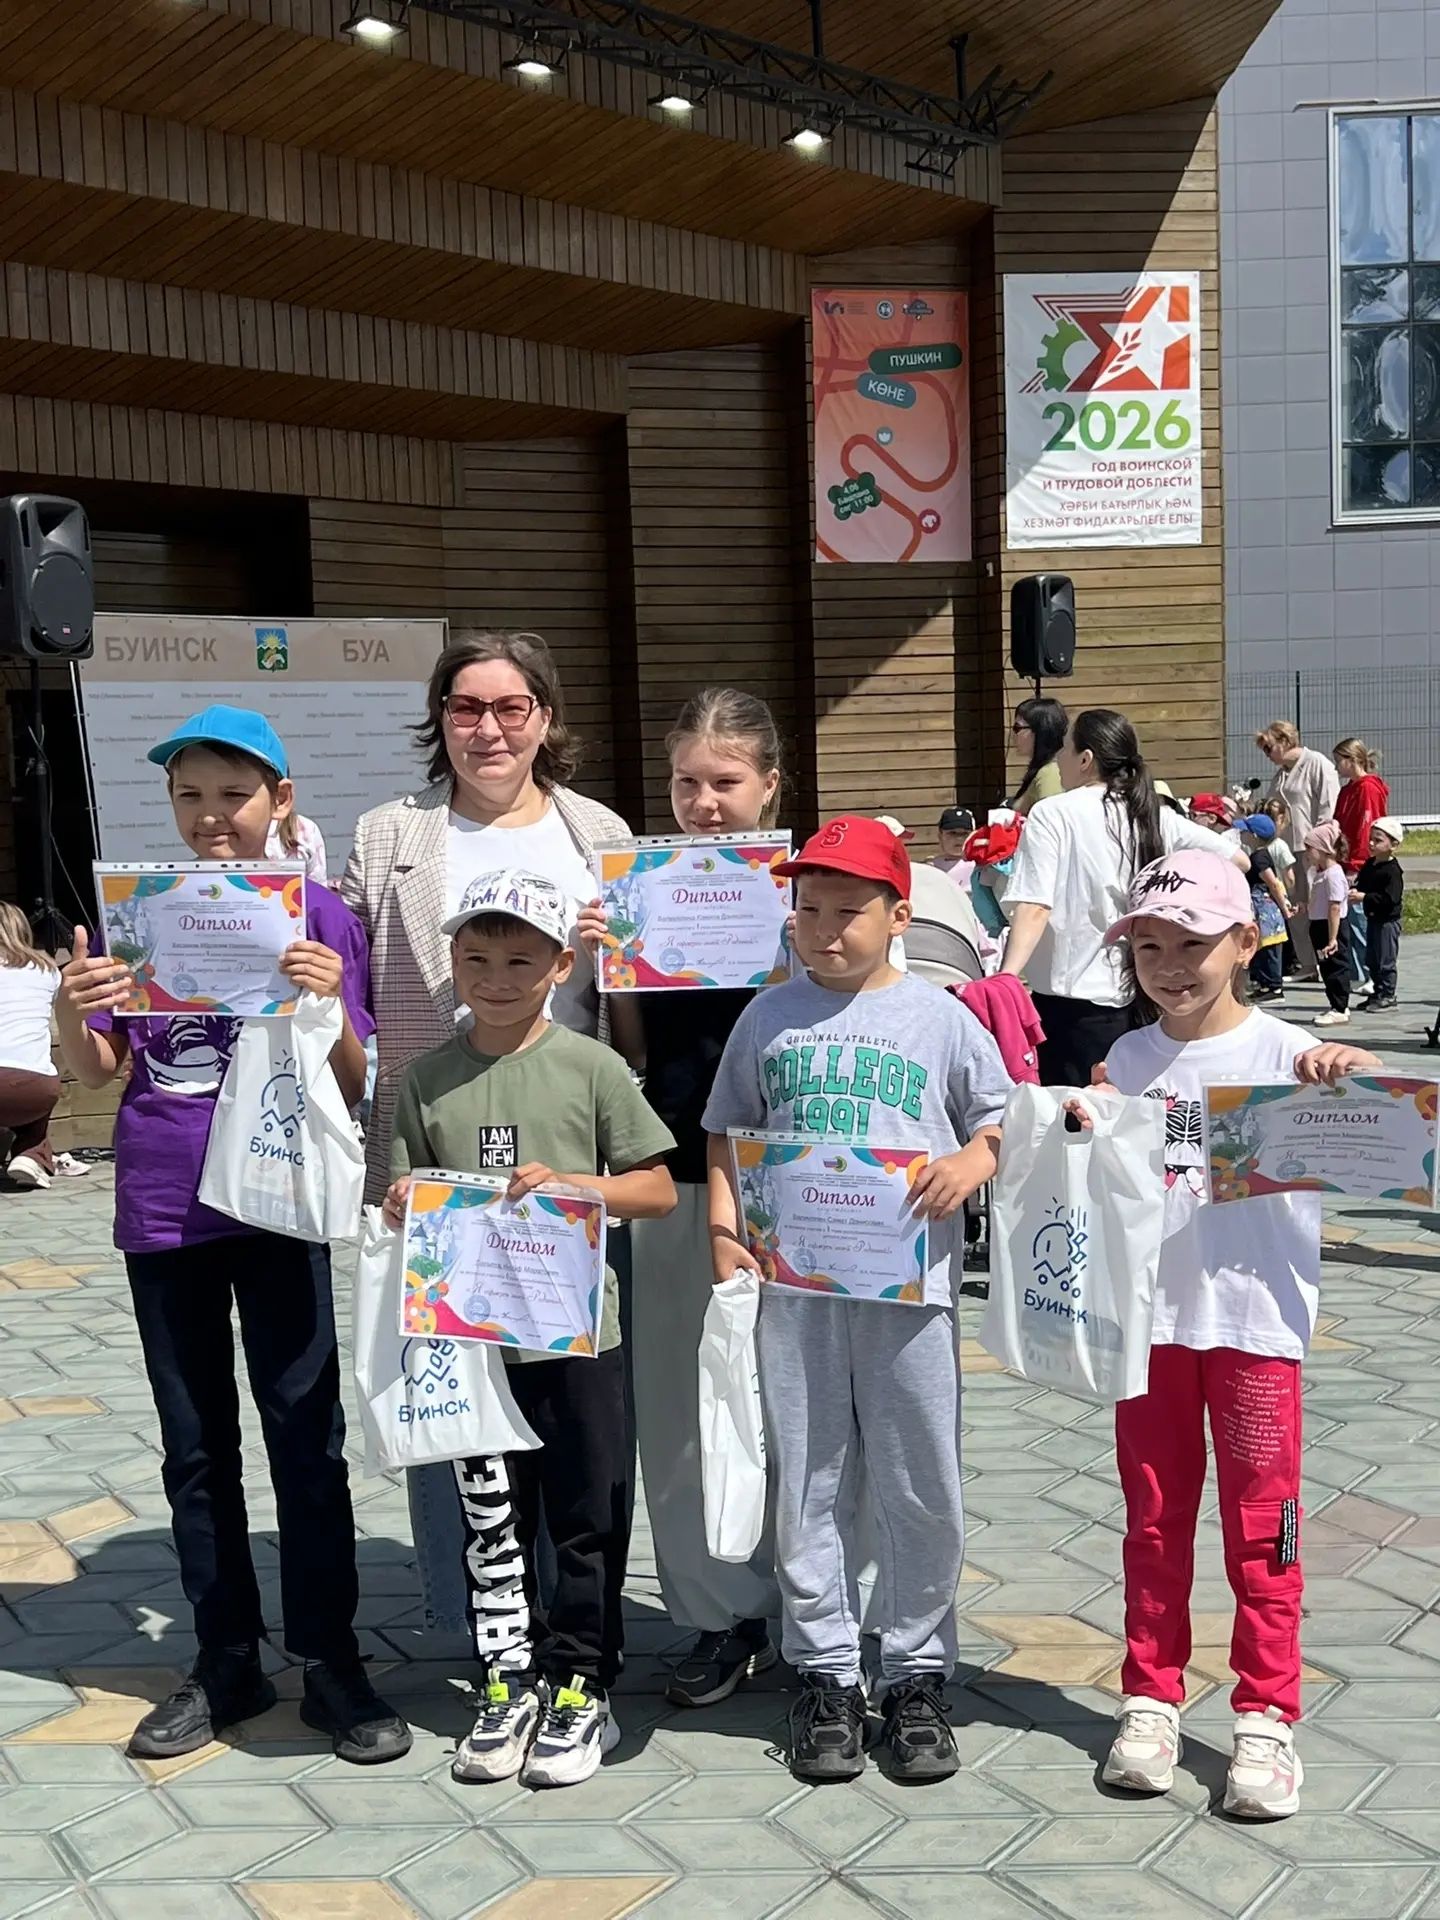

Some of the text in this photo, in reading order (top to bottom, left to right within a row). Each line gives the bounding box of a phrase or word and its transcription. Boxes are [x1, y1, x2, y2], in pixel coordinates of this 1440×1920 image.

[890, 352, 942, 367] ПУШКИН
[868, 380, 906, 402] КӨНЕ
[1041, 399, 1191, 452] 2026
[1092, 458, 1192, 473] ГОД ВОИНСКОЙ
[1043, 476, 1192, 490] И ТРУДОВОЙ ДОБЛЕСТИ
[1060, 501, 1097, 511] ХӘРБИ
[1101, 499, 1161, 510] БАТЫРЛЫК
[1023, 517, 1070, 528] ХЕЗМӘТ
[1169, 513, 1192, 524] ЕЛЫ
[105, 636, 390, 663] БУИНСК БУА
[820, 821, 848, 848] S
[672, 888, 742, 904] Диплом
[178, 914, 252, 931] Диплом
[786, 1034, 899, 1051] ORIGINAL ATHLETIC
[764, 1045, 928, 1121] COLLEGE
[793, 1097, 871, 1135] 1991
[1292, 1111, 1380, 1125] Диплом
[481, 1127, 513, 1145] I AM
[250, 1136, 305, 1167] Буинс
[482, 1148, 515, 1167] NEW
[801, 1186, 876, 1207] Диплом
[486, 1232, 556, 1256] Диплом
